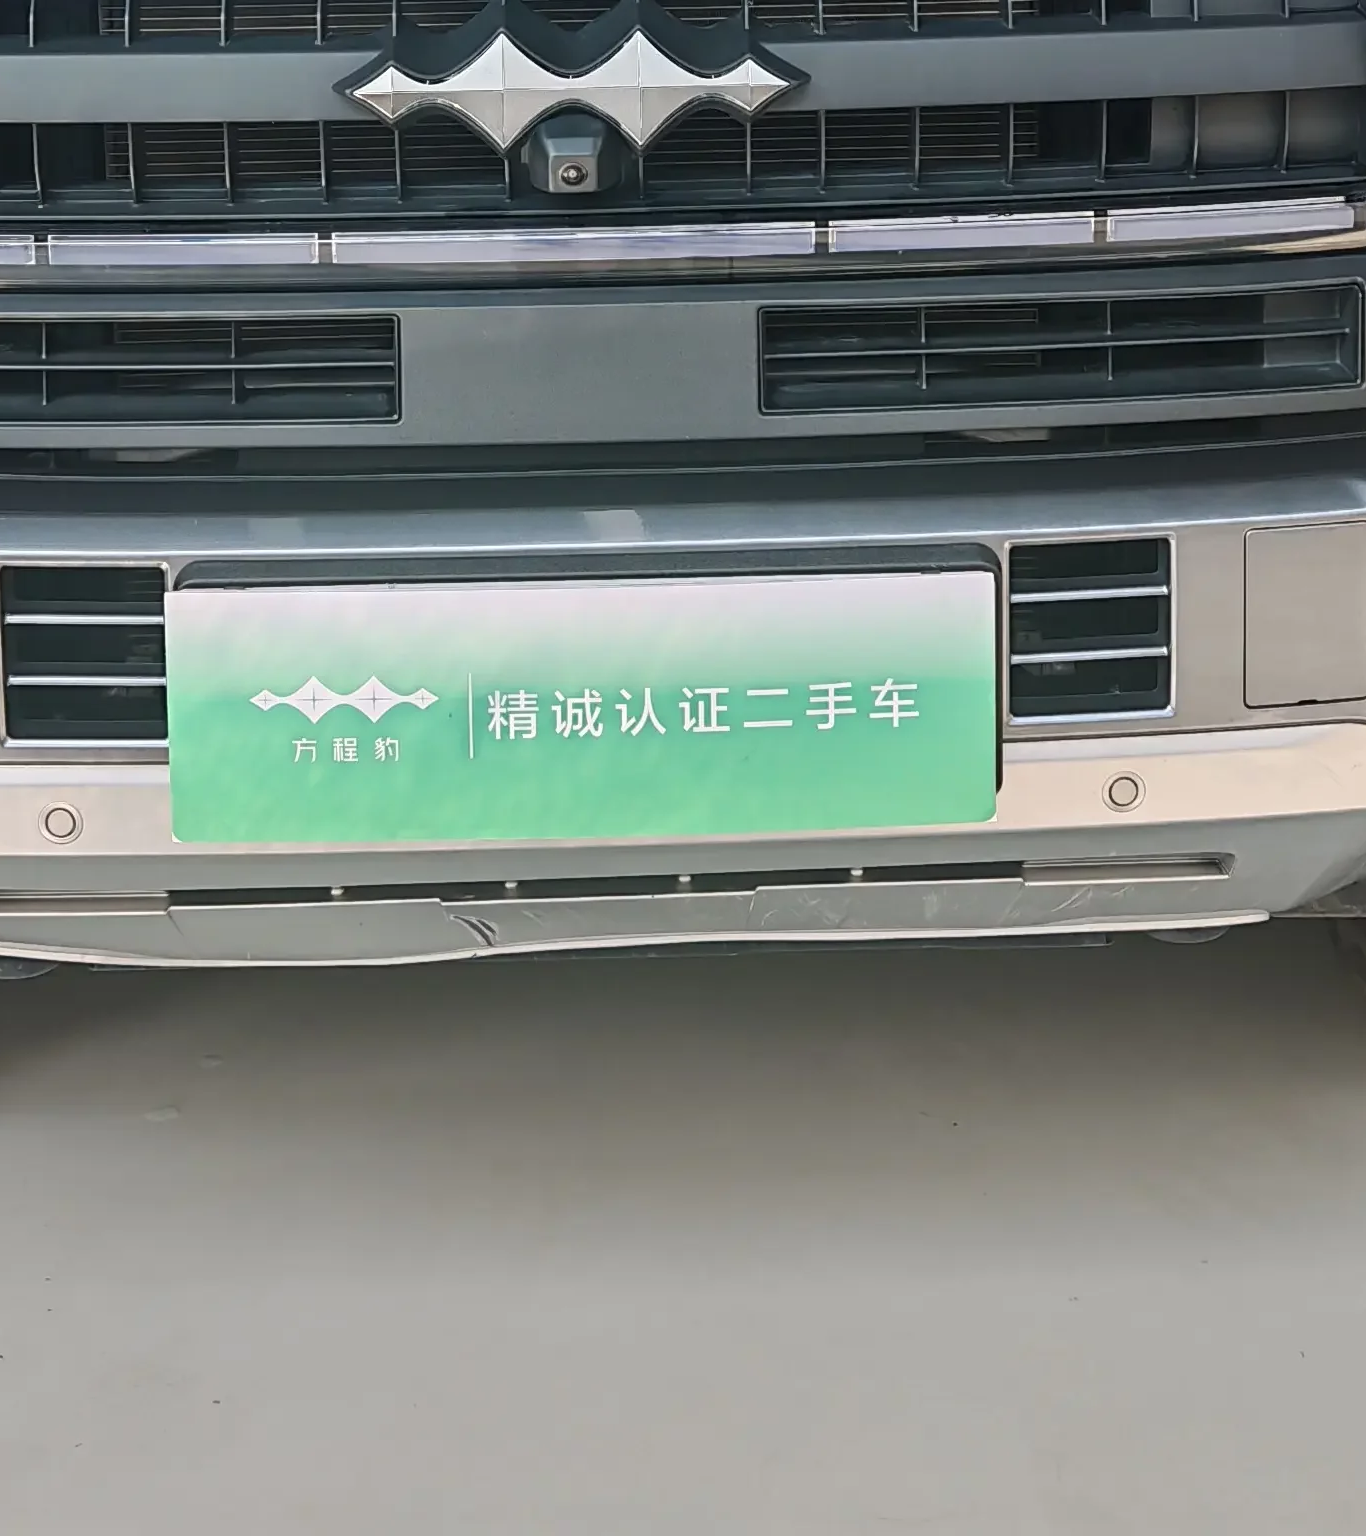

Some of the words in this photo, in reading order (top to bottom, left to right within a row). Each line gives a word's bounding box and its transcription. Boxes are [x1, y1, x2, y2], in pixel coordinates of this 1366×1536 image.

[486, 678, 921, 741] 精诚认证二手车
[291, 737, 401, 763] 方程豹
